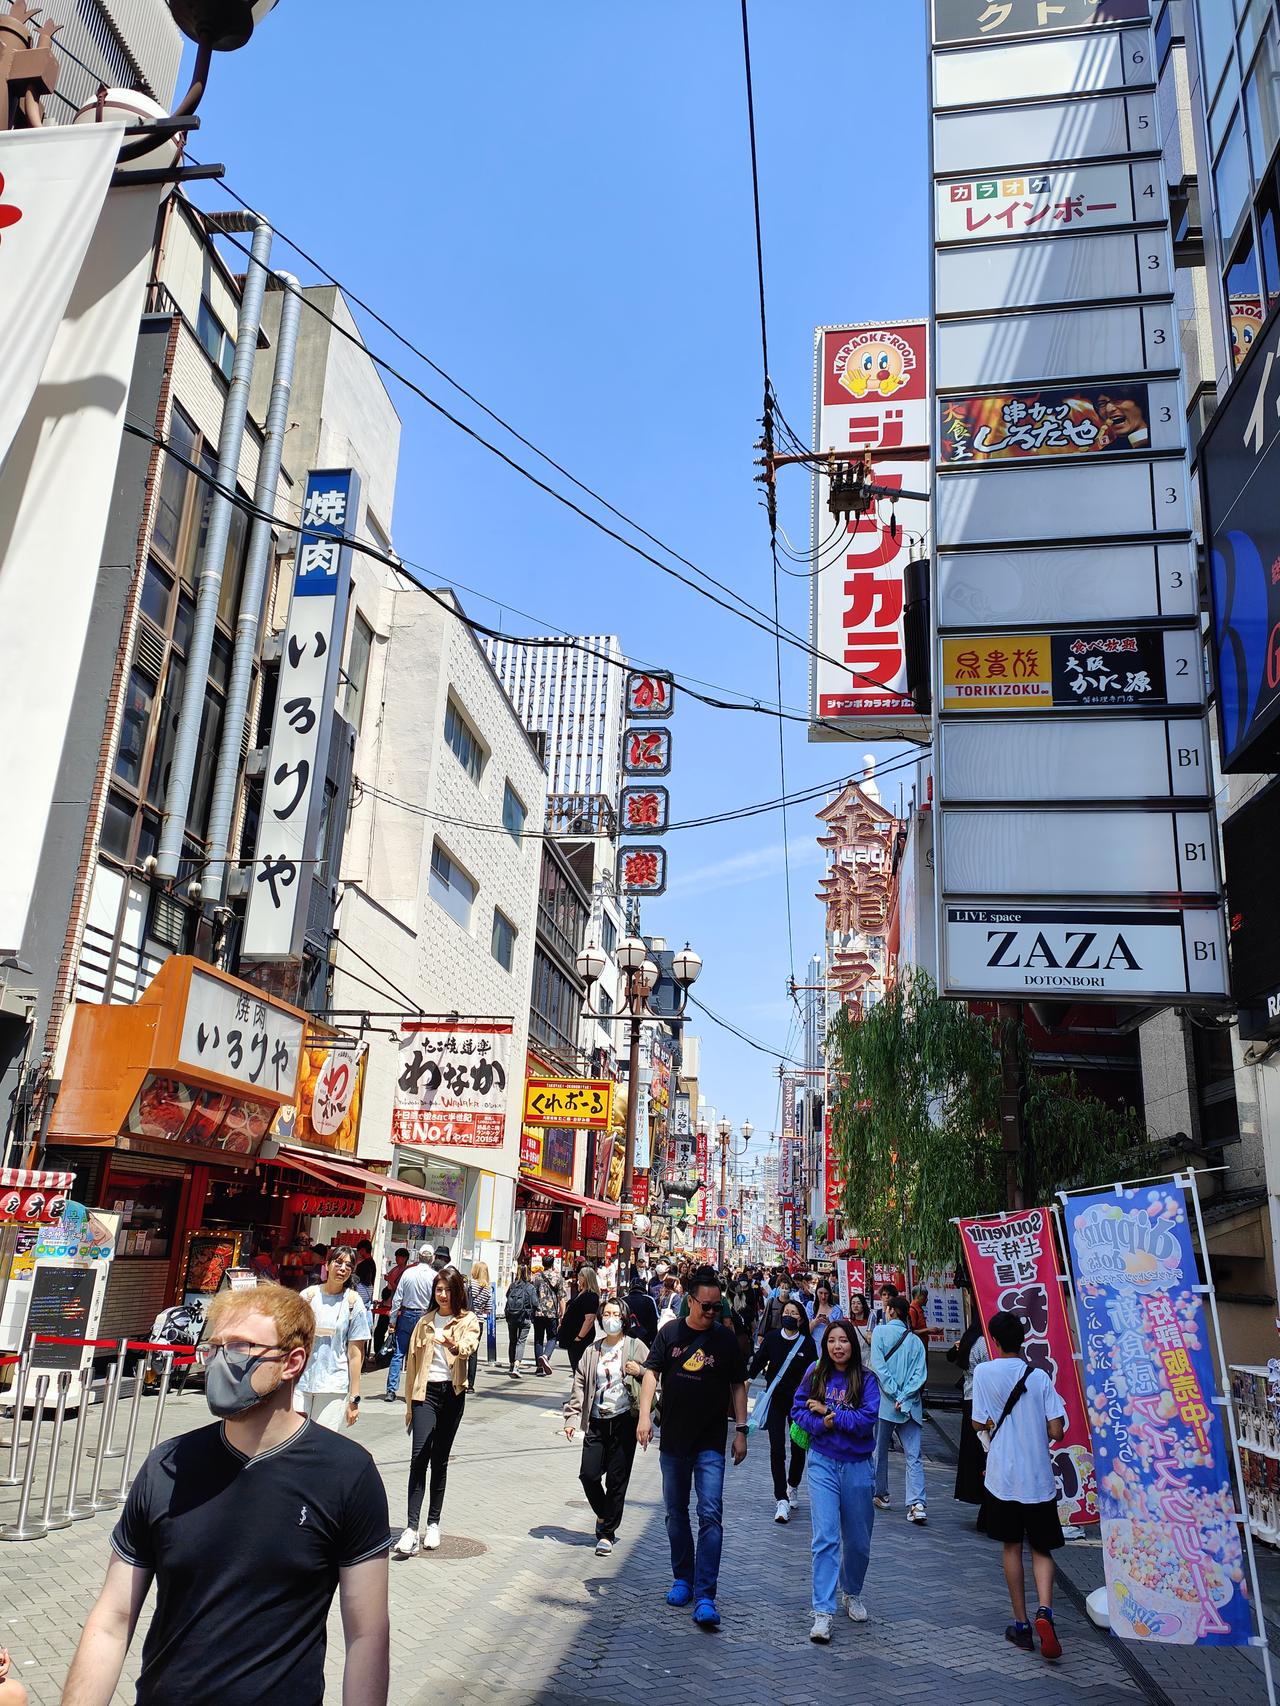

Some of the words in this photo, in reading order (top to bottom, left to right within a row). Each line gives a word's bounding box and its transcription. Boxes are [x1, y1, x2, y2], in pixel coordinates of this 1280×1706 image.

[1132, 51, 1144, 64] 6
[1138, 115, 1149, 129] 5
[951, 177, 1050, 201] カラオケ
[1143, 184, 1155, 198] 4
[965, 195, 1117, 232] レインボー
[1148, 256, 1160, 270] 3
[1153, 330, 1166, 345] 3
[1160, 407, 1171, 423] 3
[943, 402, 974, 461] 大食王
[973, 420, 1099, 452] しろたや
[1165, 487, 1178, 504] 3
[299, 490, 346, 577] 焼肉
[843, 409, 904, 688] ジンカラ
[1170, 571, 1183, 589] 3
[1070, 637, 1138, 654] 食べ放題
[955, 649, 1040, 679] 鳥貴族
[1064, 656, 1111, 673] 大阪
[1176, 659, 1189, 676] 2
[955, 684, 1040, 697] TORIKIZOKU
[1070, 671, 1152, 694] かに源
[827, 698, 915, 709] ジャンボカラオケ広
[1177, 748, 1200, 766] B1
[257, 631, 327, 909] いろりや
[1184, 842, 1207, 861] B1
[956, 911, 986, 922] LIVE
[990, 912, 1021, 925] space
[986, 931, 1143, 971] ZAZA
[1194, 941, 1217, 960] B1
[1024, 974, 1106, 987] DOTONBORI
[235, 992, 267, 1030] 焼肉
[197, 1022, 289, 1091] いろりや
[398, 1050, 505, 1096] わなか
[531, 1090, 603, 1114] くれおーる
[412, 1121, 454, 1142] No.1
